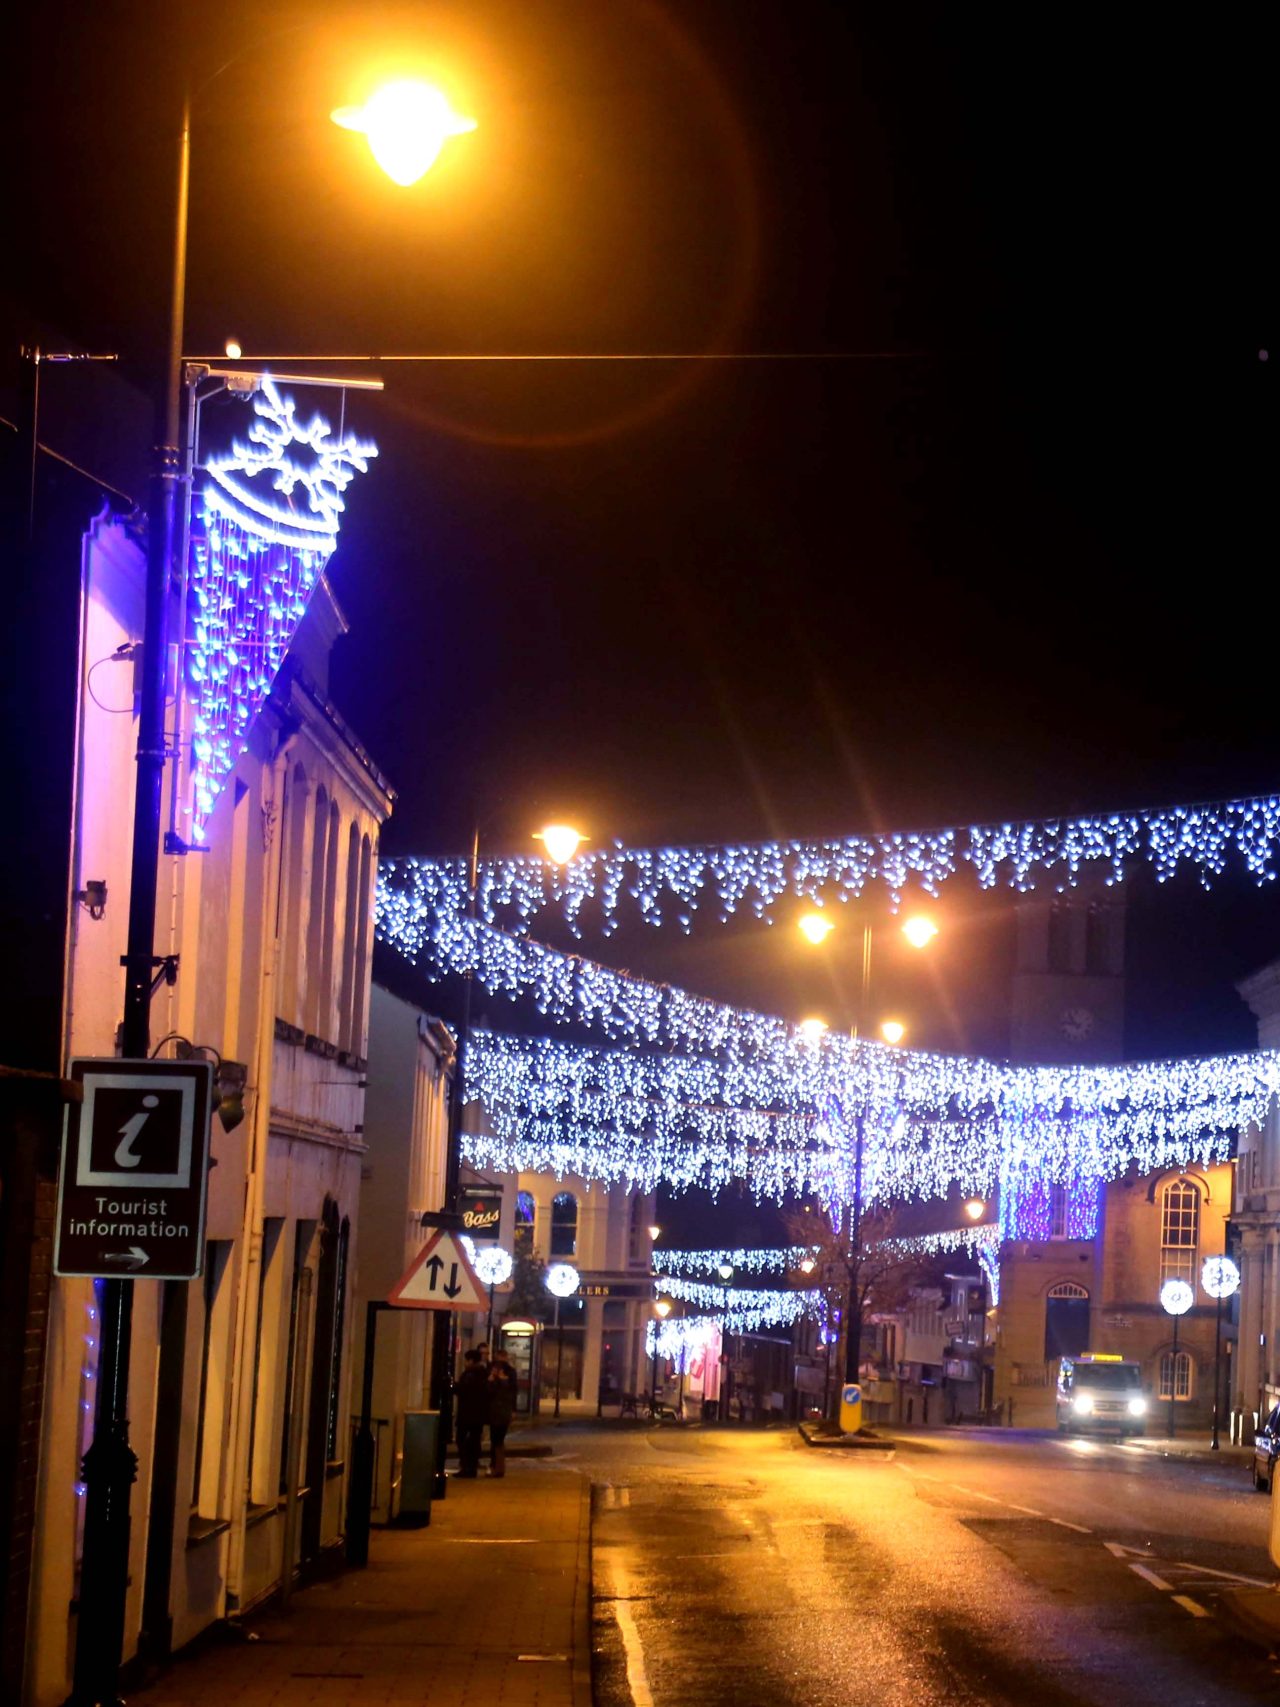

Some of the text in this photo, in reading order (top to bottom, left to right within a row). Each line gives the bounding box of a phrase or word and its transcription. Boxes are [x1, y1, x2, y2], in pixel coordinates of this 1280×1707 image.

[95, 1197, 168, 1216] Tourist
[69, 1218, 189, 1238] information
[462, 1209, 500, 1229] Bass
[578, 1286, 610, 1296] LERS
